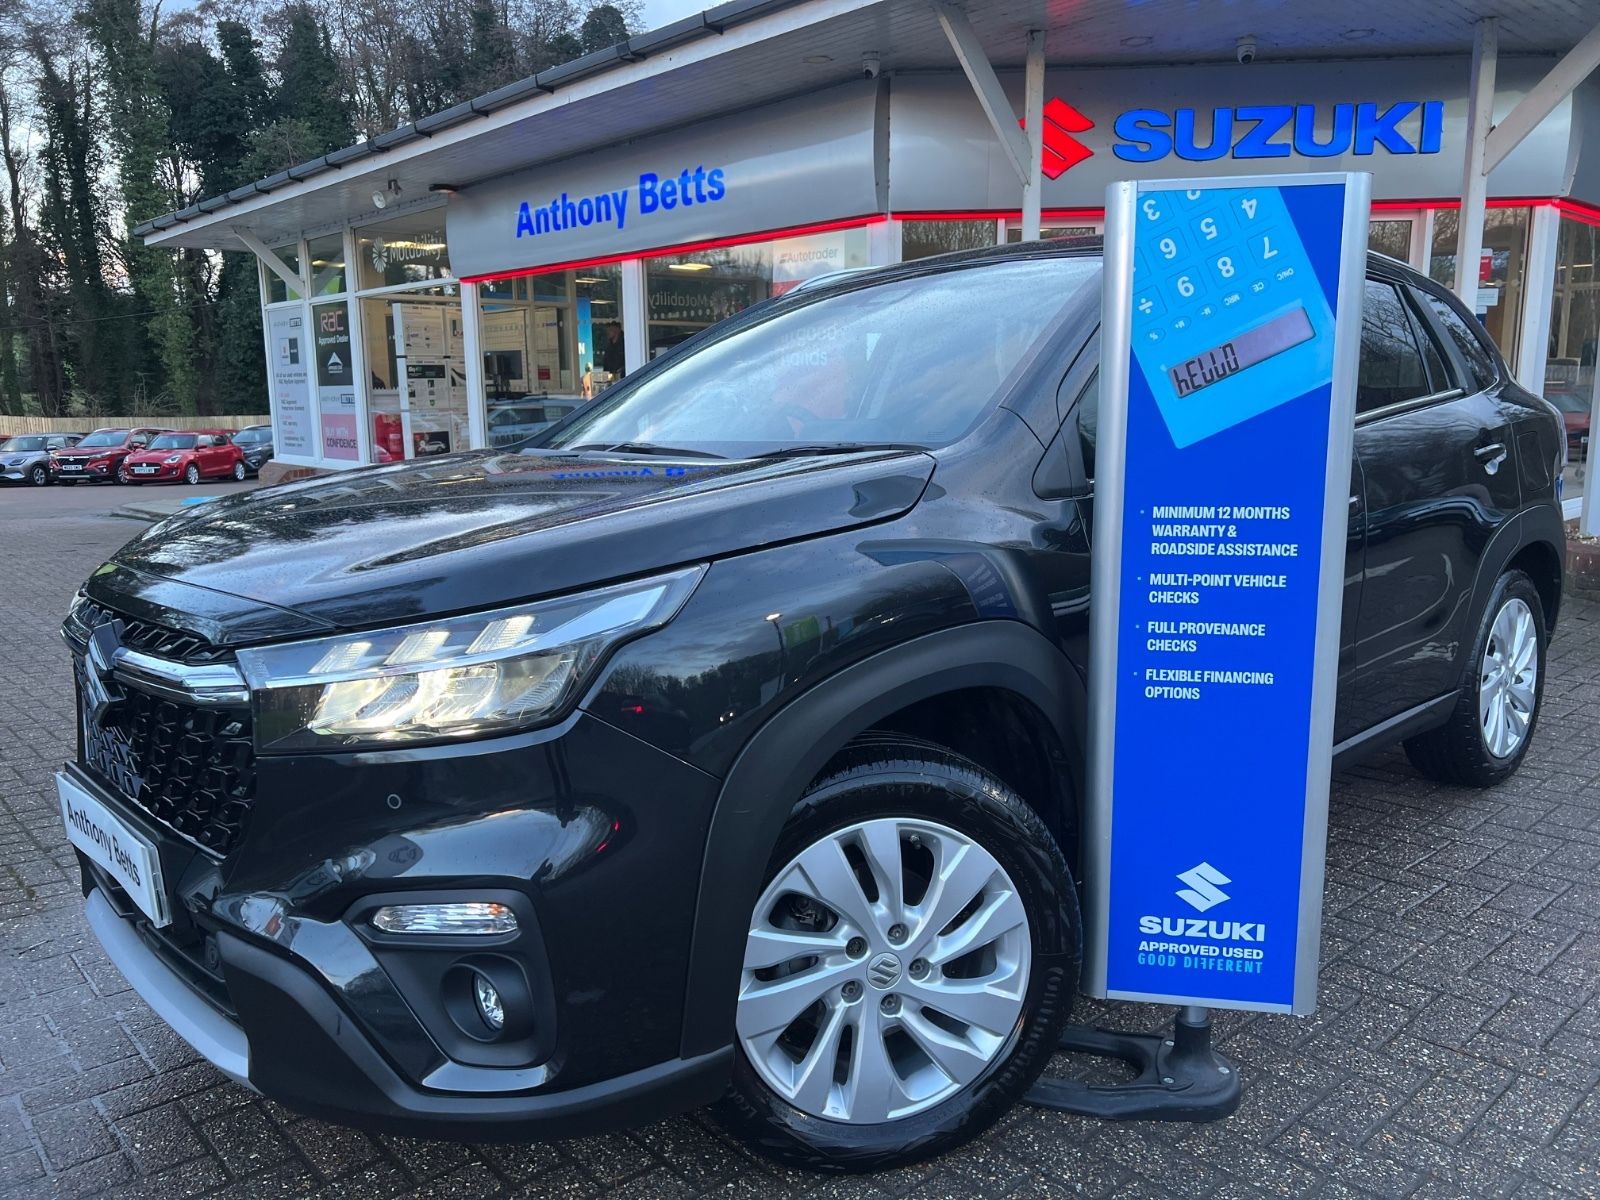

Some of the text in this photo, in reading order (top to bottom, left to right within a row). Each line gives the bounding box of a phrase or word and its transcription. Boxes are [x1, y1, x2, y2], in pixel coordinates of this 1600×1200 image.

[1113, 101, 1444, 163] SUZUKI
[515, 165, 726, 238] Anthony Betts
[1143, 199, 1160, 220] 3
[1241, 198, 1257, 219] 4
[1200, 217, 1218, 240] 5
[788, 247, 839, 264] Autotrader
[1263, 236, 1278, 259] 7
[1217, 256, 1235, 278] 8
[326, 437, 357, 449] CONFIDENCE
[1152, 506, 1290, 520] MINIMUM 12 MONTHS
[1152, 524, 1237, 537] WARRANTY &
[1151, 543, 1298, 557] ROADSIDE ASSISTANCE
[1149, 573, 1287, 587] MULTI-POINT VEHICLE
[1149, 591, 1199, 604] CHECKS
[1147, 621, 1266, 636] FULL PROVENANCE
[1147, 639, 1197, 652] CHECKS
[1145, 669, 1274, 685] FLEXIBLE FINANCING
[1145, 686, 1200, 700] OPTIONS
[66, 799, 141, 887] Anthony Betts
[1139, 915, 1266, 942] SUZUKI
[1138, 941, 1264, 960] APPROVED USED
[1138, 952, 1263, 974] GOOD DIFFERENT
